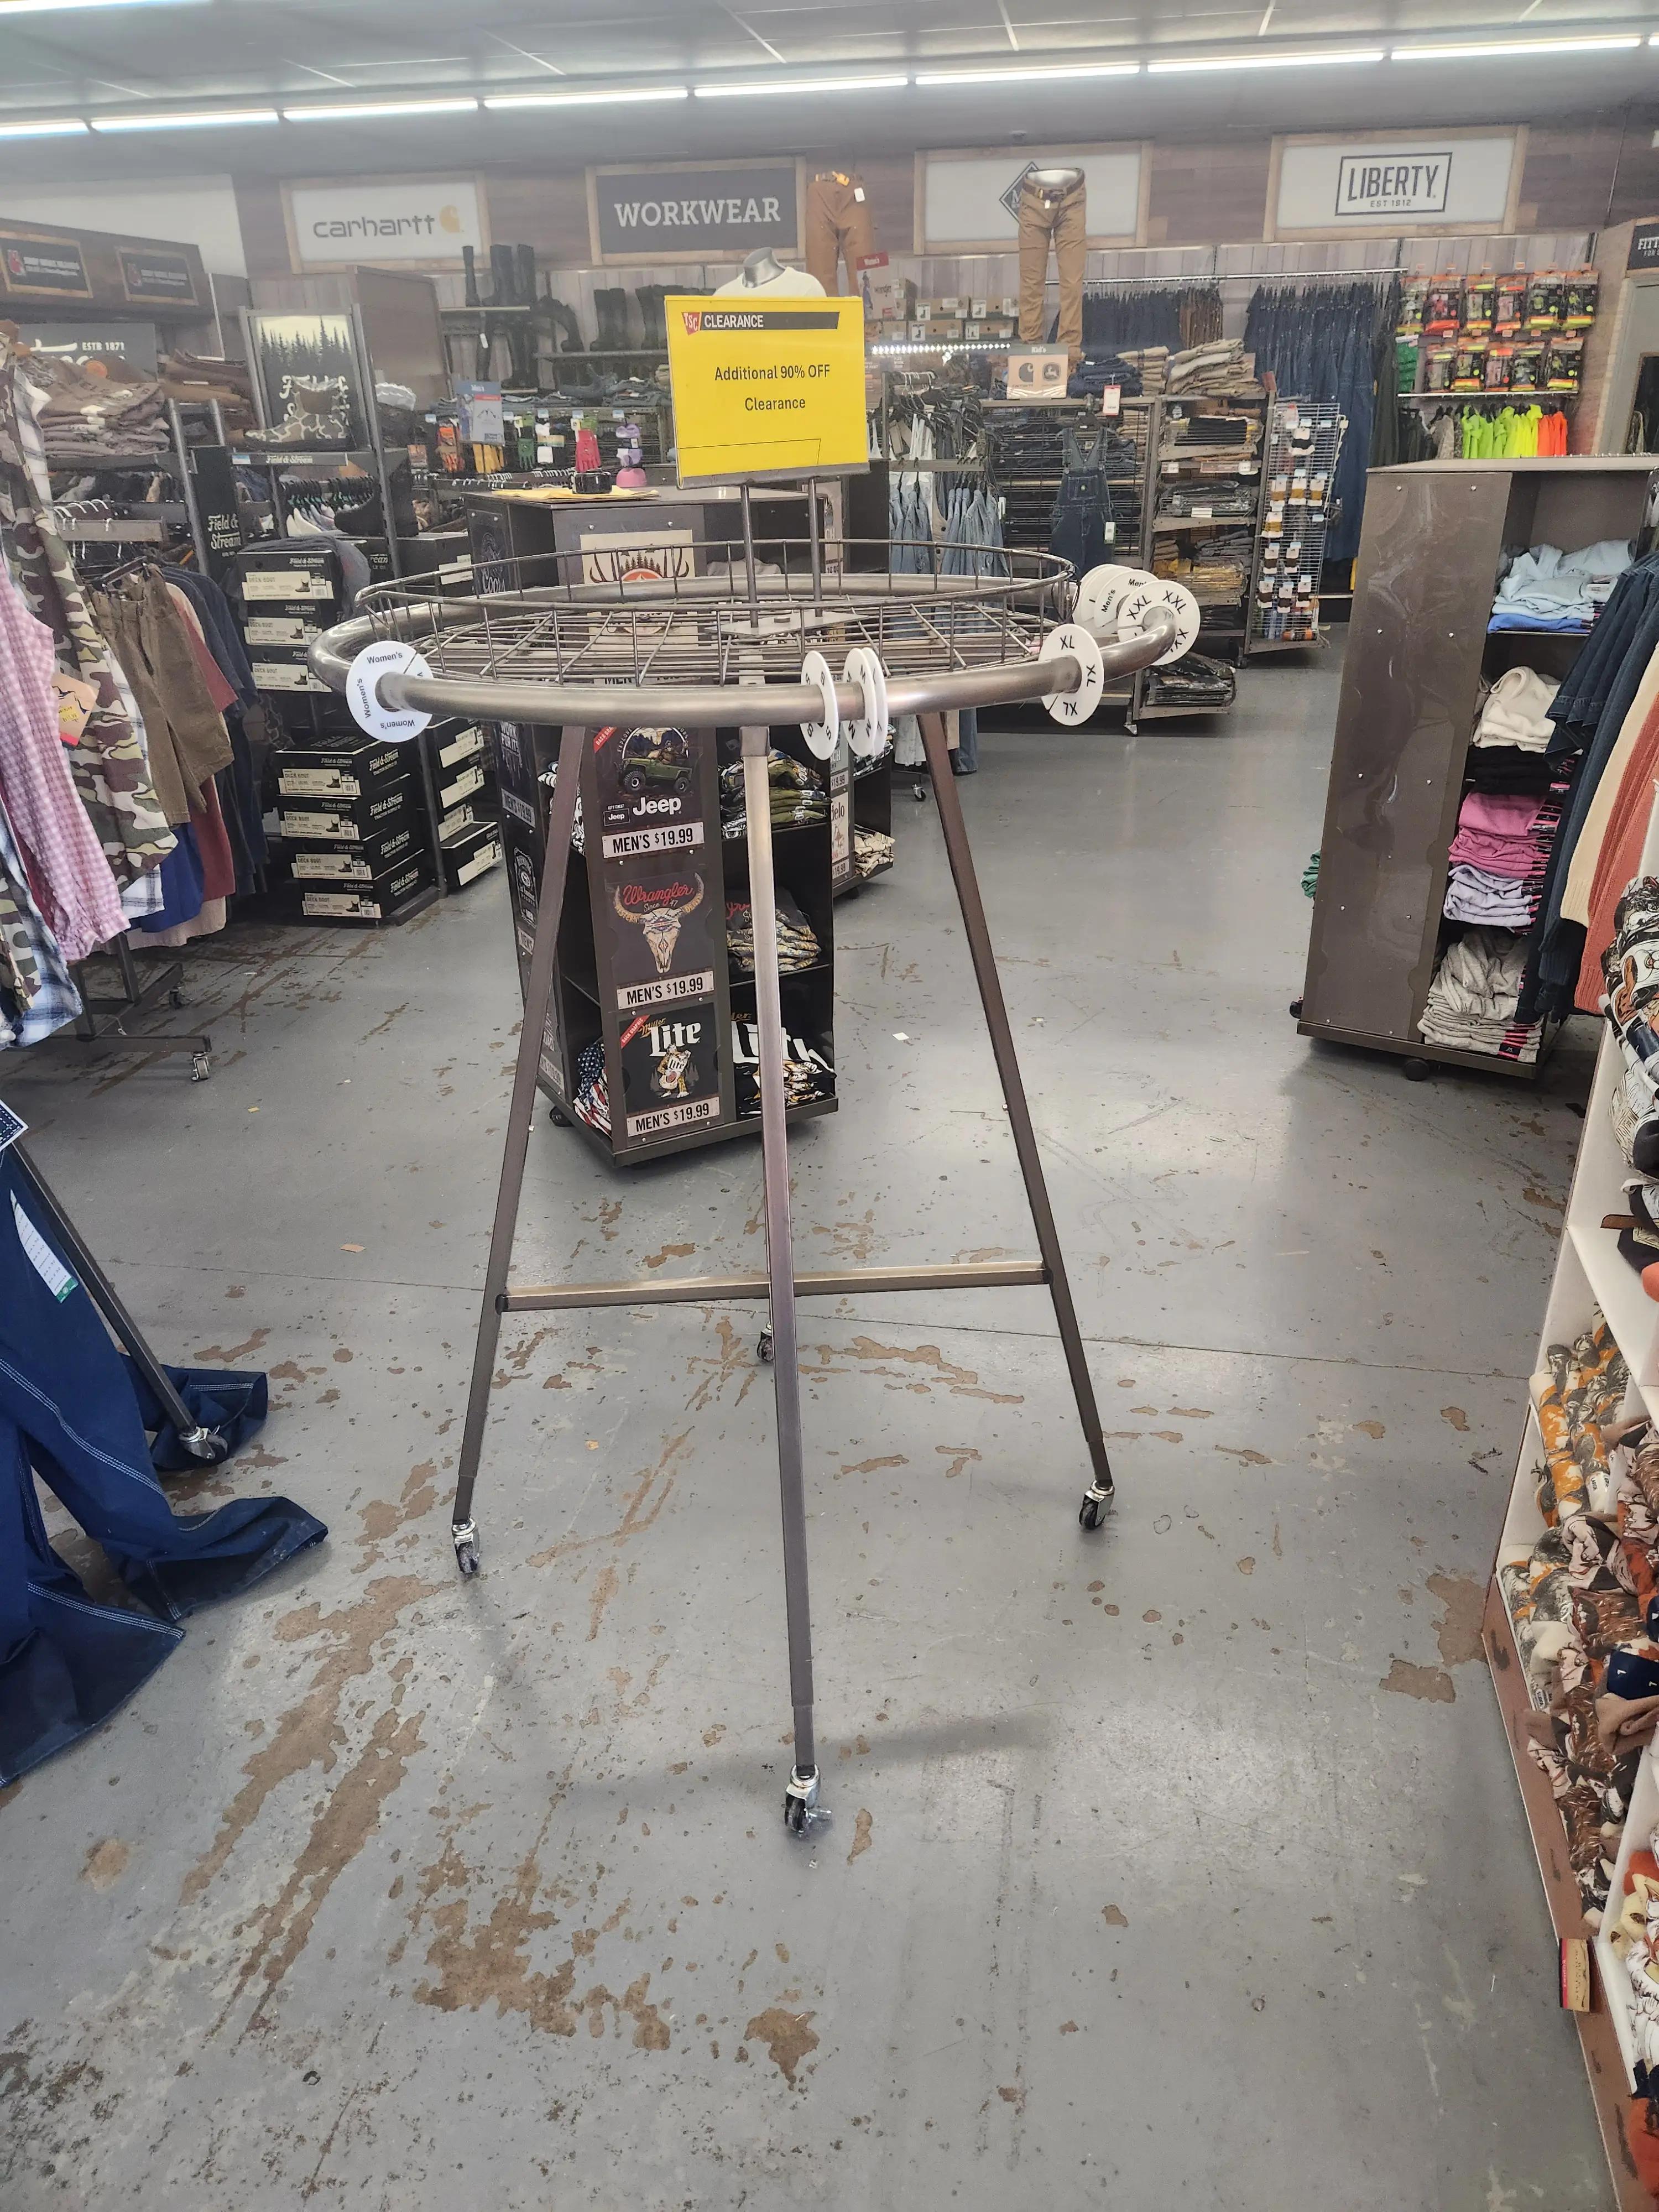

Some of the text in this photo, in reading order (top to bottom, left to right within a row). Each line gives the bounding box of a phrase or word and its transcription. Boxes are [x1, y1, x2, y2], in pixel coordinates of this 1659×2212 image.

[1348, 165, 1439, 201] LIBERTY
[614, 197, 781, 227] WORKWEAR
[313, 215, 435, 238] carhartt
[1637, 237, 1659, 250] FITT
[684, 312, 764, 331] TSC CLEARANCE
[105, 341, 126, 351] 1871
[715, 364, 830, 380] Additional 90% OFF
[745, 397, 806, 411] Clearance
[208, 513, 239, 531] Field &
[211, 531, 242, 550] Stream
[1128, 578, 1147, 587] Men'
[1101, 589, 1115, 612] Men's
[1126, 595, 1152, 620] XXL
[1162, 590, 1187, 614] XXL
[1060, 635, 1074, 650] XL
[1170, 628, 1189, 653] XX
[367, 652, 403, 664] Women's
[820, 672, 825, 686] S
[1086, 664, 1096, 687] XL
[356, 678, 372, 718] Women's
[1063, 701, 1078, 716] XL
[380, 719, 415, 729] Women's
[807, 723, 813, 737] S
[826, 726, 831, 740] S
[369, 758, 380, 772] Field
[384, 749, 400, 762] Stream
[831, 775, 846, 787] $19.99
[369, 802, 383, 817] Field
[387, 792, 404, 807] Stream
[633, 796, 682, 816] Jeep
[380, 841, 392, 855] Field
[395, 830, 410, 844] Stream
[613, 827, 695, 854] MEN'S $19.99
[390, 878, 401, 893] Field
[623, 882, 693, 906] Wrangler
[643, 899, 679, 912] Since '47
[627, 977, 703, 1005] MEN'S $19.99
[622, 1018, 644, 1044] BACK GRAPHIC
[638, 1018, 666, 1039] Miller
[649, 1022, 701, 1057] Lite
[669, 1059, 685, 1070] Lite
[635, 1103, 709, 1132] MEN'S $19.99
